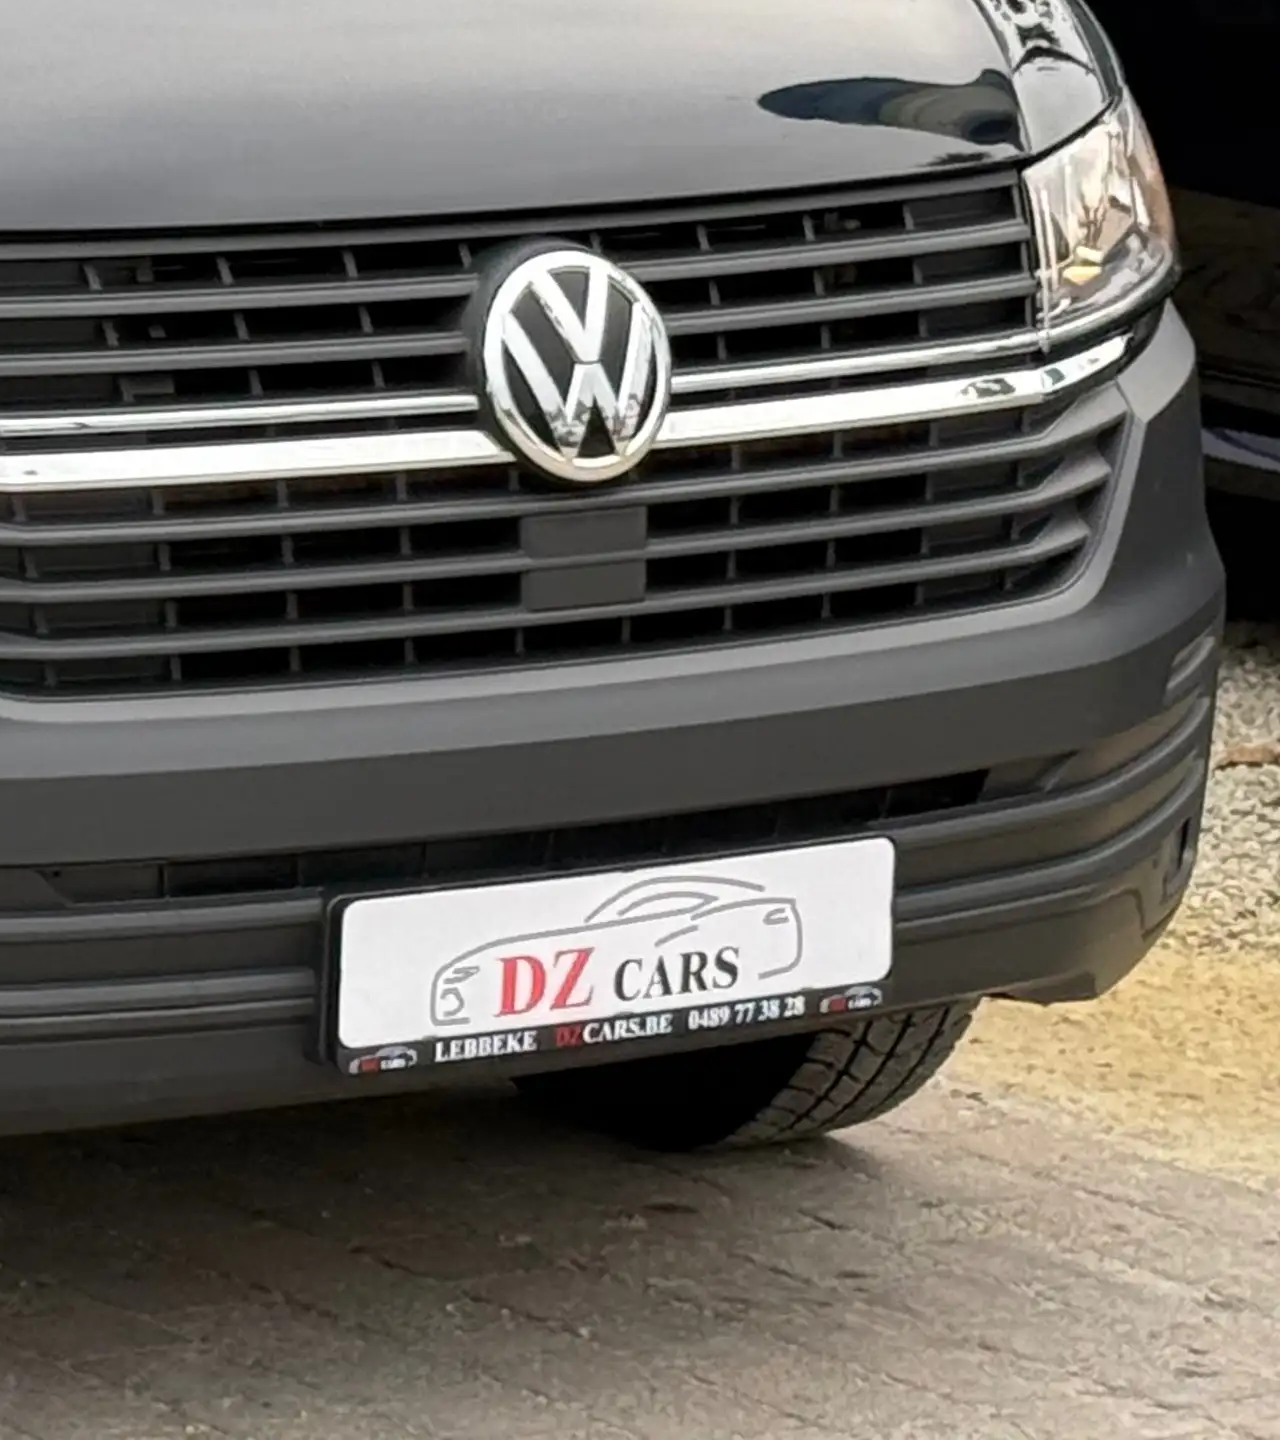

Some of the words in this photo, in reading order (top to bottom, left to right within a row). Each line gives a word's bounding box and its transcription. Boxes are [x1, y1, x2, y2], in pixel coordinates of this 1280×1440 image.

[495, 947, 594, 1017] DZ
[613, 946, 740, 1002] CARS
[435, 1030, 538, 1062] LEBBEKE
[688, 1006, 730, 1030] 0489
[734, 1001, 757, 1024] 77
[758, 997, 781, 1021] 38
[784, 995, 806, 1018] 28
